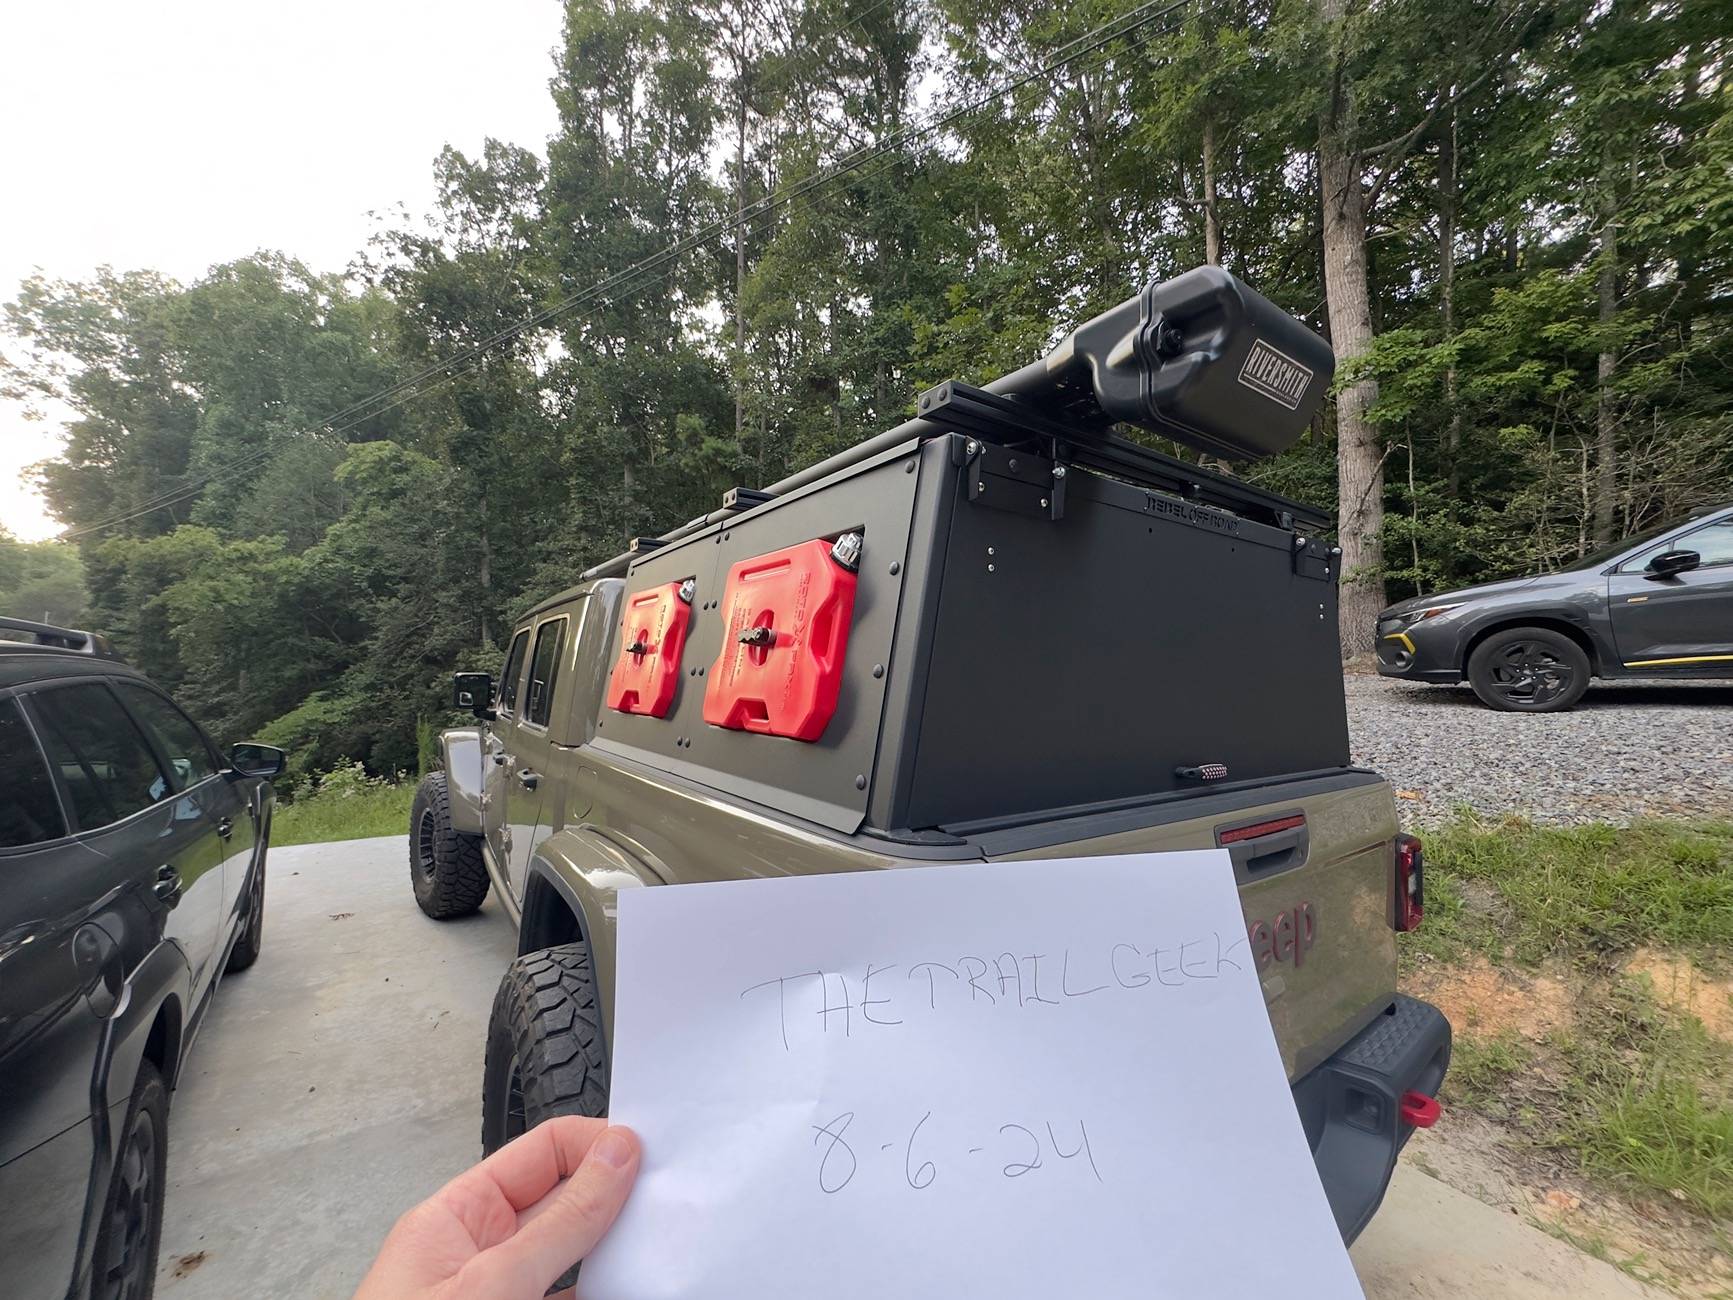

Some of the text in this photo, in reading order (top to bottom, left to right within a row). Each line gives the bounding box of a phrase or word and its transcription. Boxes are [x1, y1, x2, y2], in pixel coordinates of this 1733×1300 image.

[1245, 346, 1309, 399] RIVERSMITH
[1146, 496, 1187, 519] REBEL
[1188, 507, 1209, 525] OFF
[1250, 901, 1313, 969] eep
